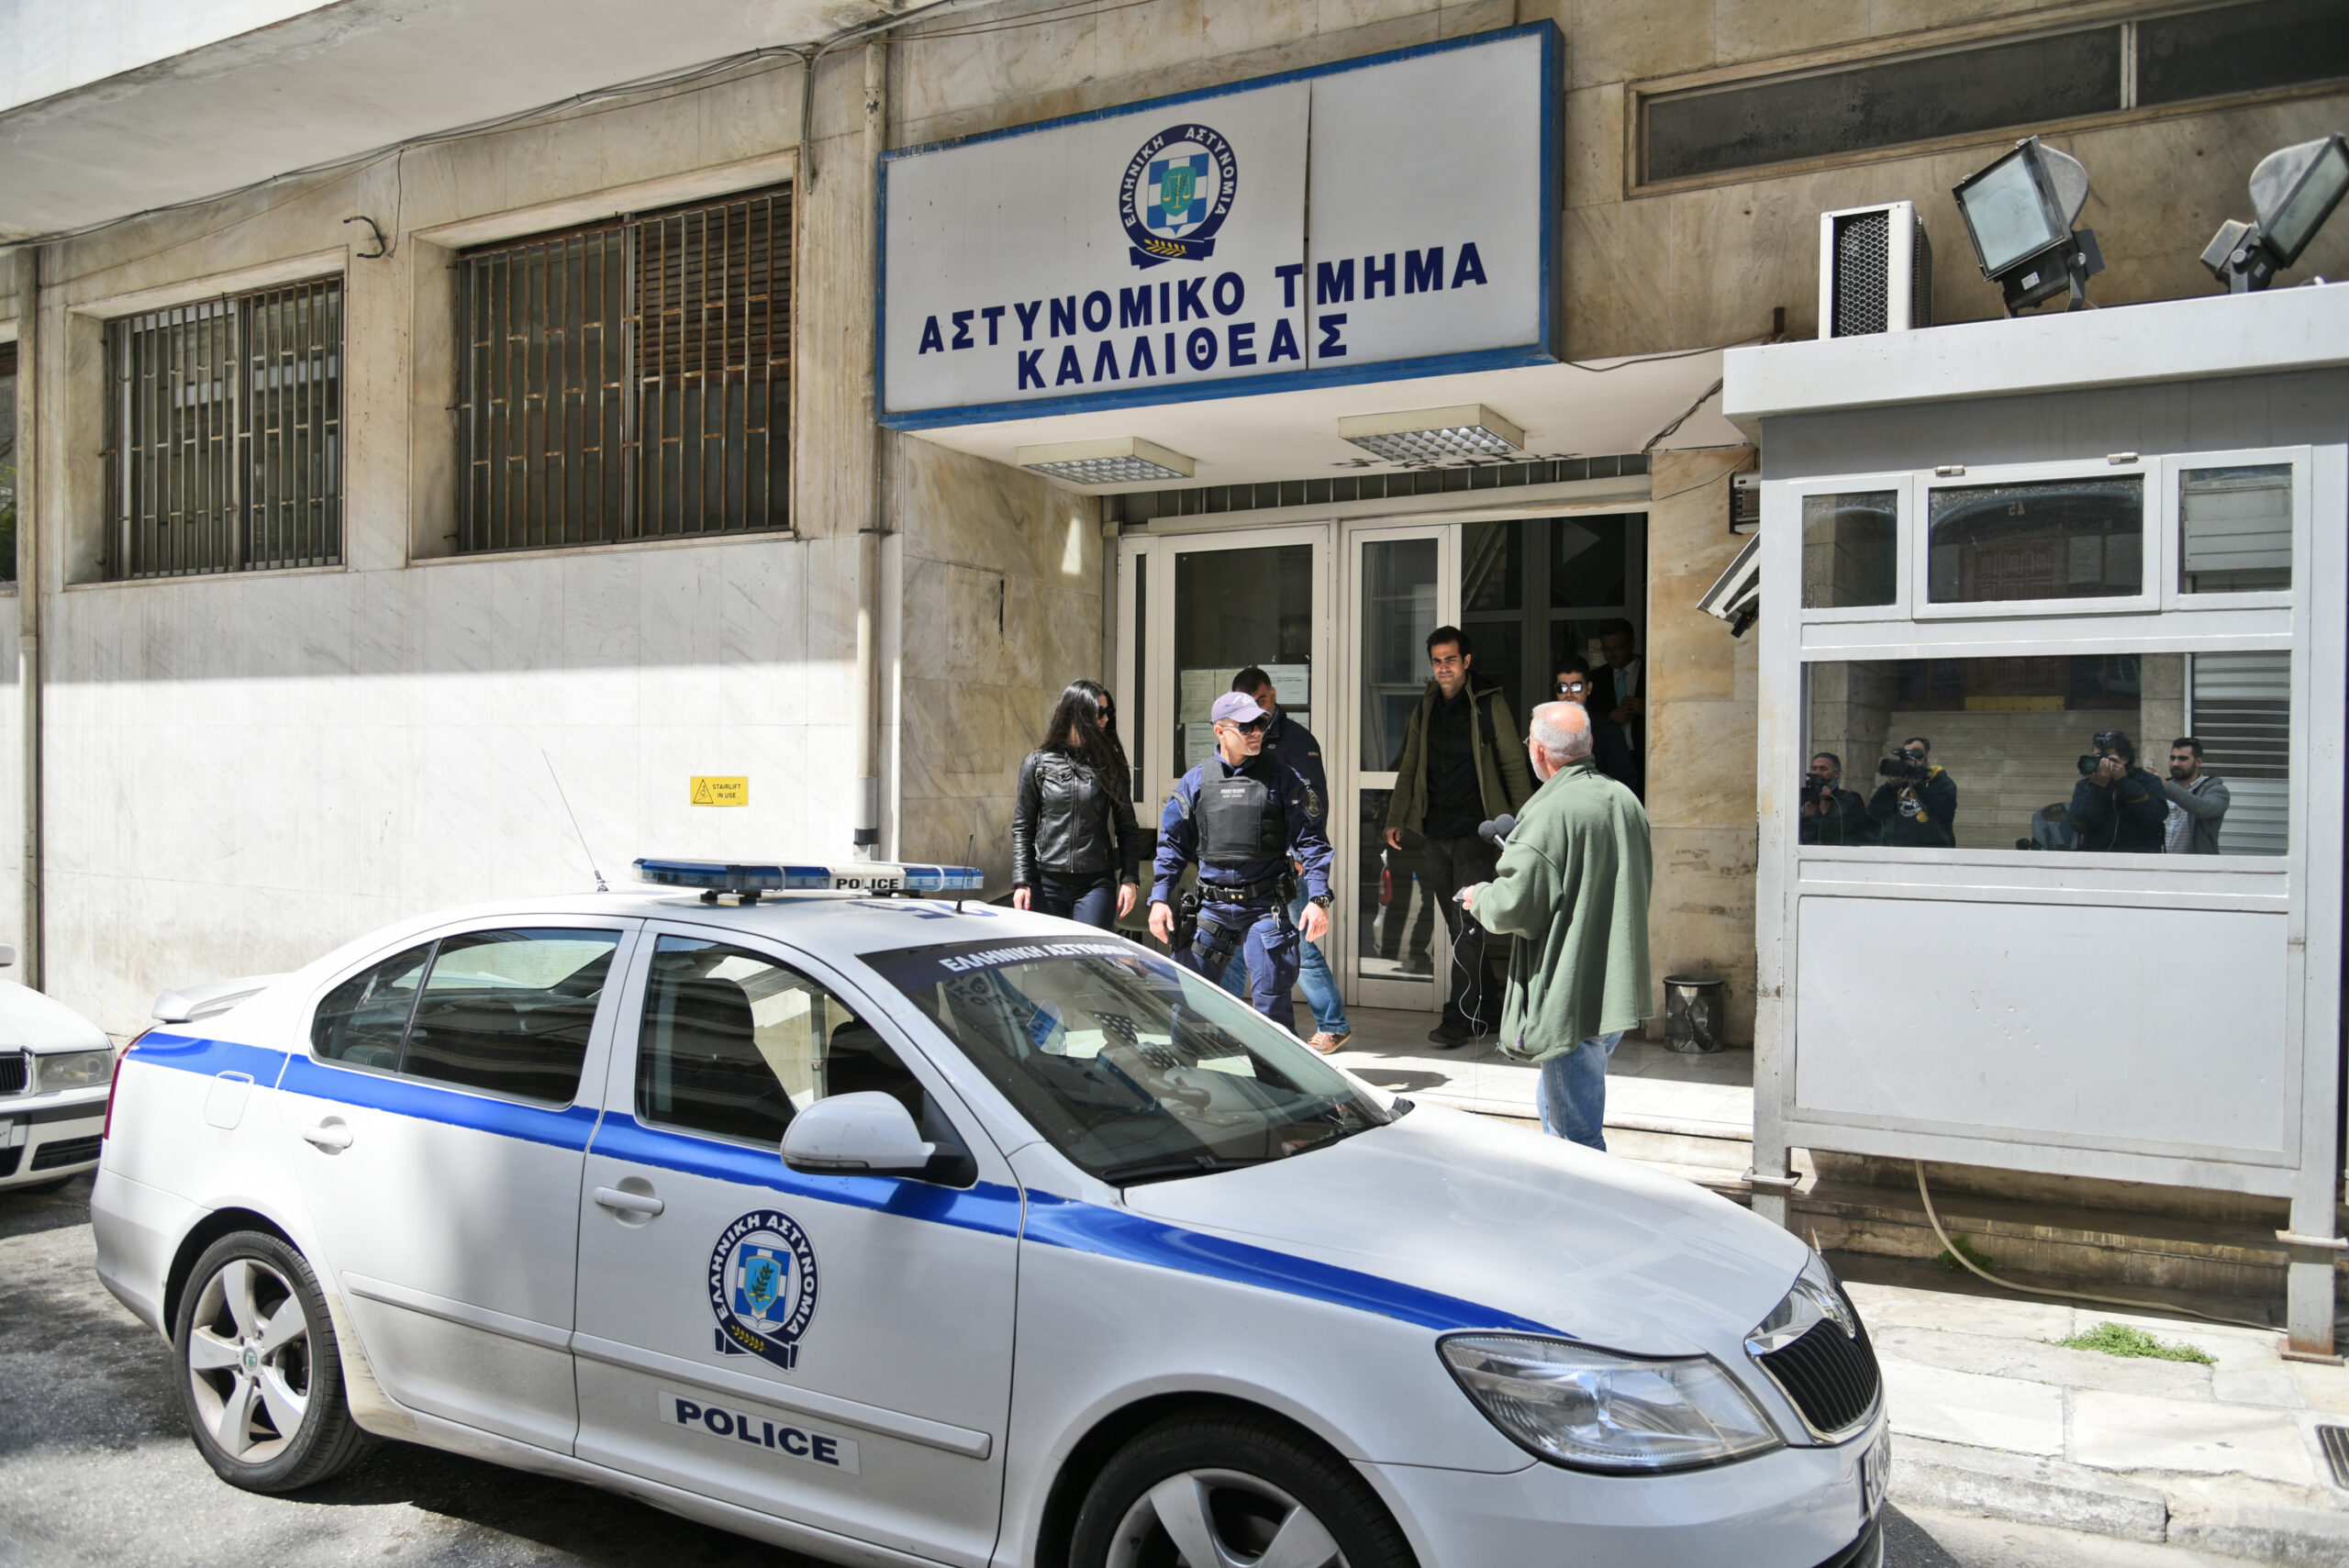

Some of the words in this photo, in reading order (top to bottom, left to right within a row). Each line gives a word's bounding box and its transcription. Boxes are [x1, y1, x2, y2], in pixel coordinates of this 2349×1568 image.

[1121, 135, 1164, 228] ΕΛΛΗΝΙΚΗ
[1185, 127, 1235, 215] ΑΣΤΥΝΟΜΙΑ
[918, 272, 1245, 355] ΑΣΤΥΝΟΜΙΚΟ
[1275, 241, 1487, 308] ΤΜΗΜΑ
[1018, 313, 1348, 391] ΚΑΛΛΙΘΕΑΣ
[938, 944, 1050, 973] ΕΛΛΗΝΙΚΗ
[711, 1214, 761, 1321] ΕΛΛΗΝΙΚΗ
[766, 1214, 815, 1336] ΑΣΤΥΝΟΜΙΑ
[675, 1397, 840, 1466] POLICE
